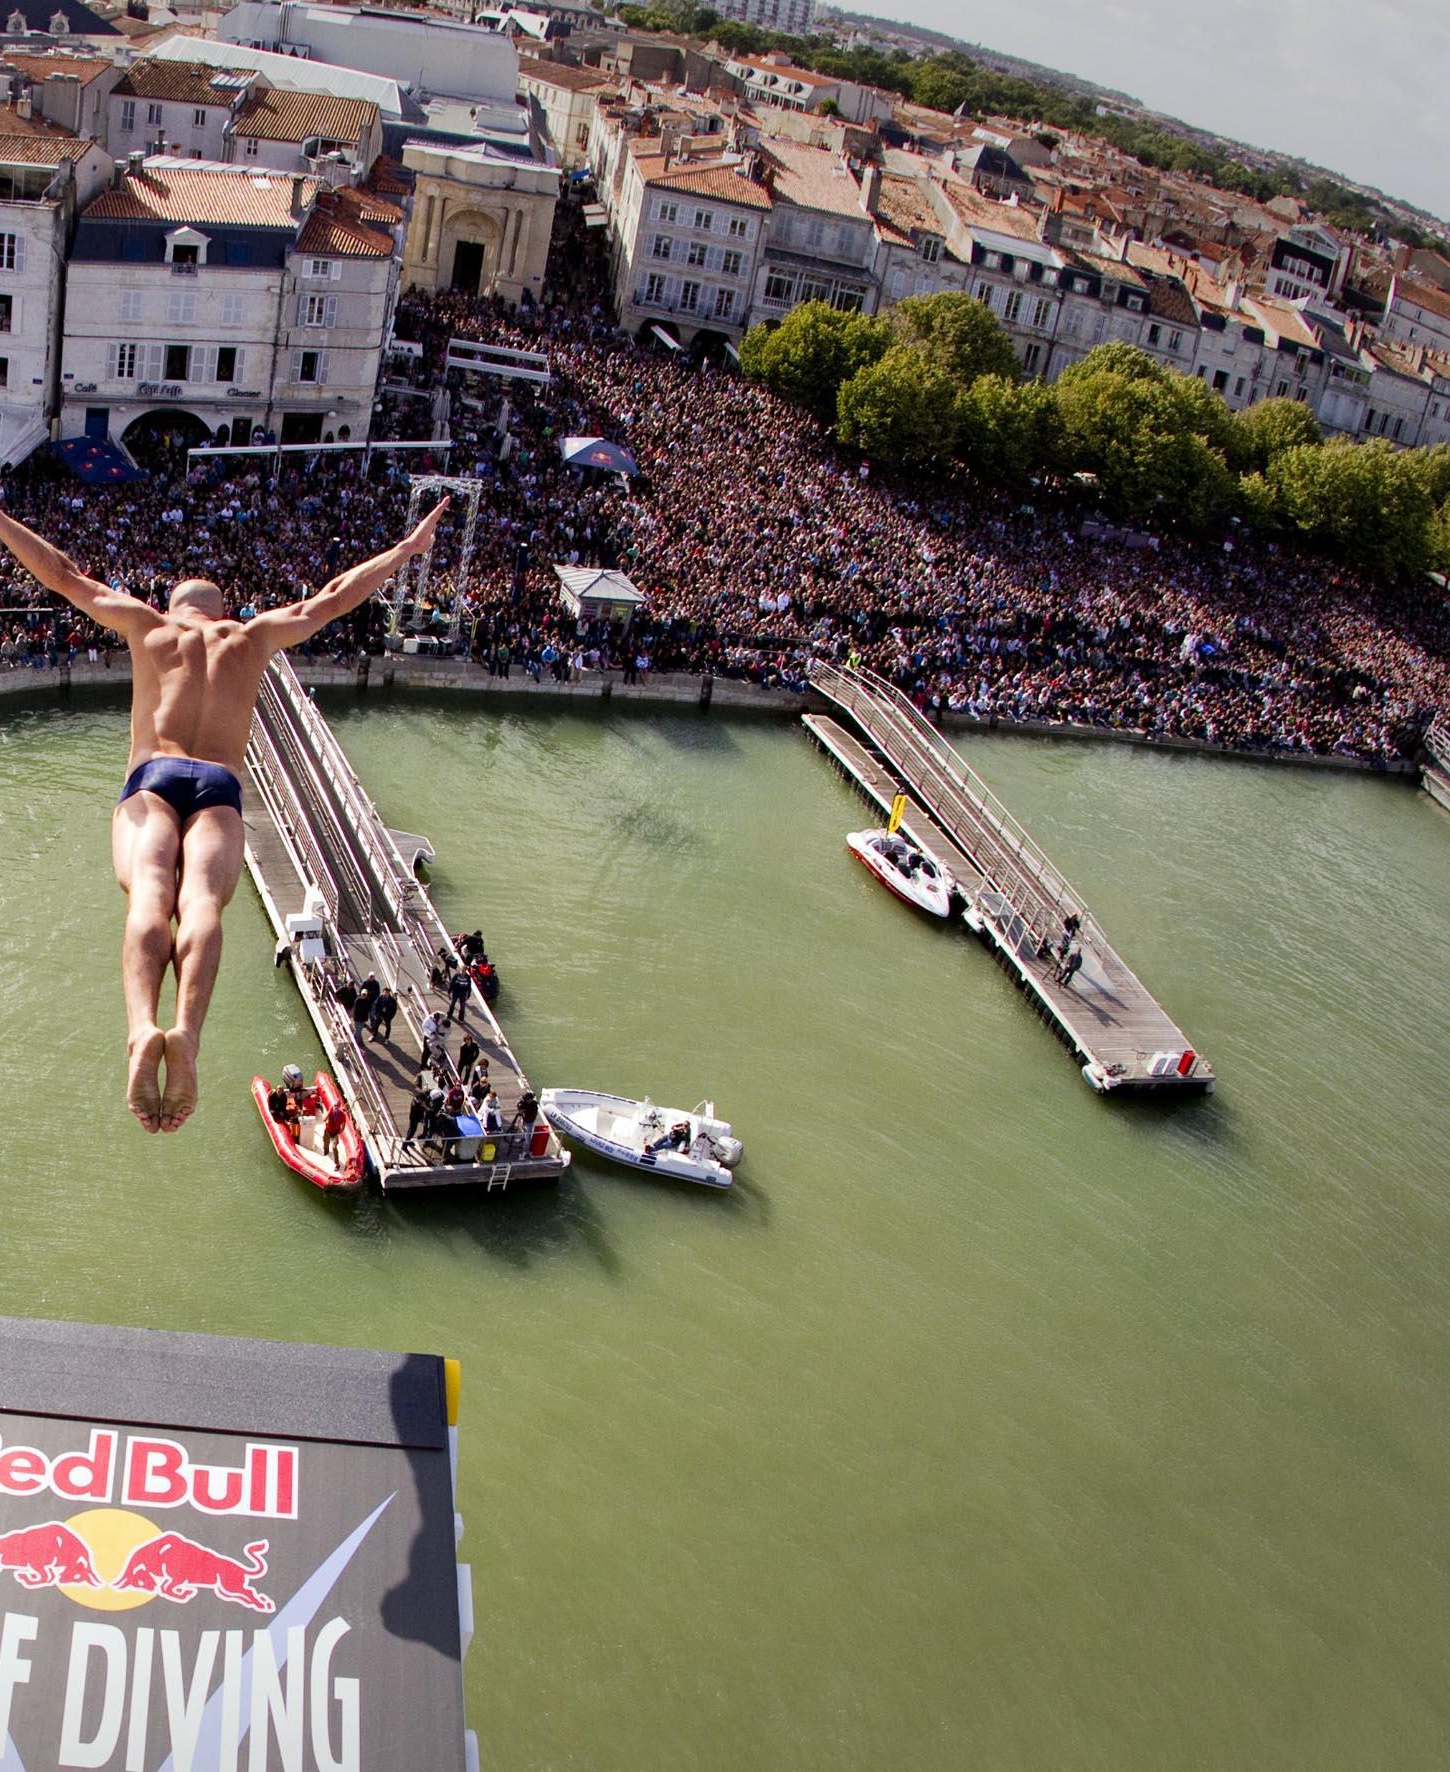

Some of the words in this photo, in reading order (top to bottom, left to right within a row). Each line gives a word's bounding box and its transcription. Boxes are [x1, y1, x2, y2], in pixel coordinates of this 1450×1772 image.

[74, 383, 98, 394] Café
[227, 387, 262, 399] Glacier
[123, 1436, 298, 1519] Bull
[58, 1616, 361, 1772] DIVING
